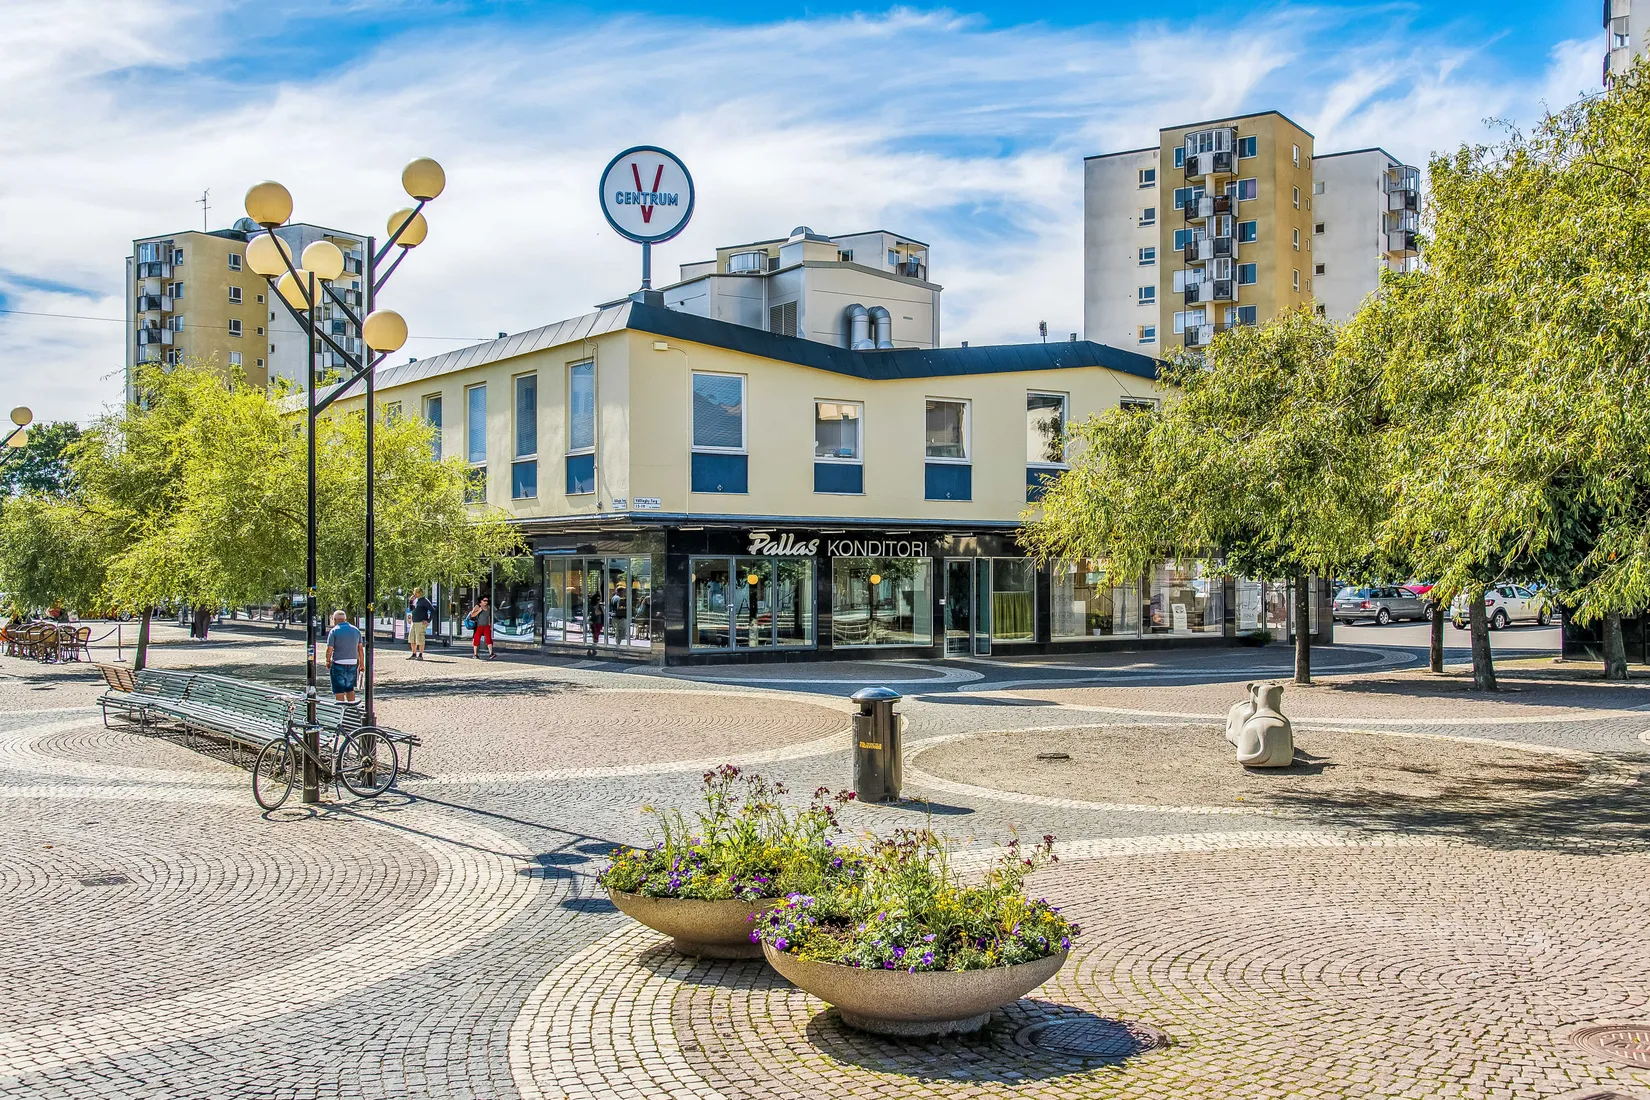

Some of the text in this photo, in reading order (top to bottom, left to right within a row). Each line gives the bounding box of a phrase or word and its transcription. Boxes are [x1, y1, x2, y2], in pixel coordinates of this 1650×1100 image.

[615, 191, 679, 206] CENTRUM
[631, 163, 664, 224] V
[748, 533, 928, 557] Pallas KONDITORI
